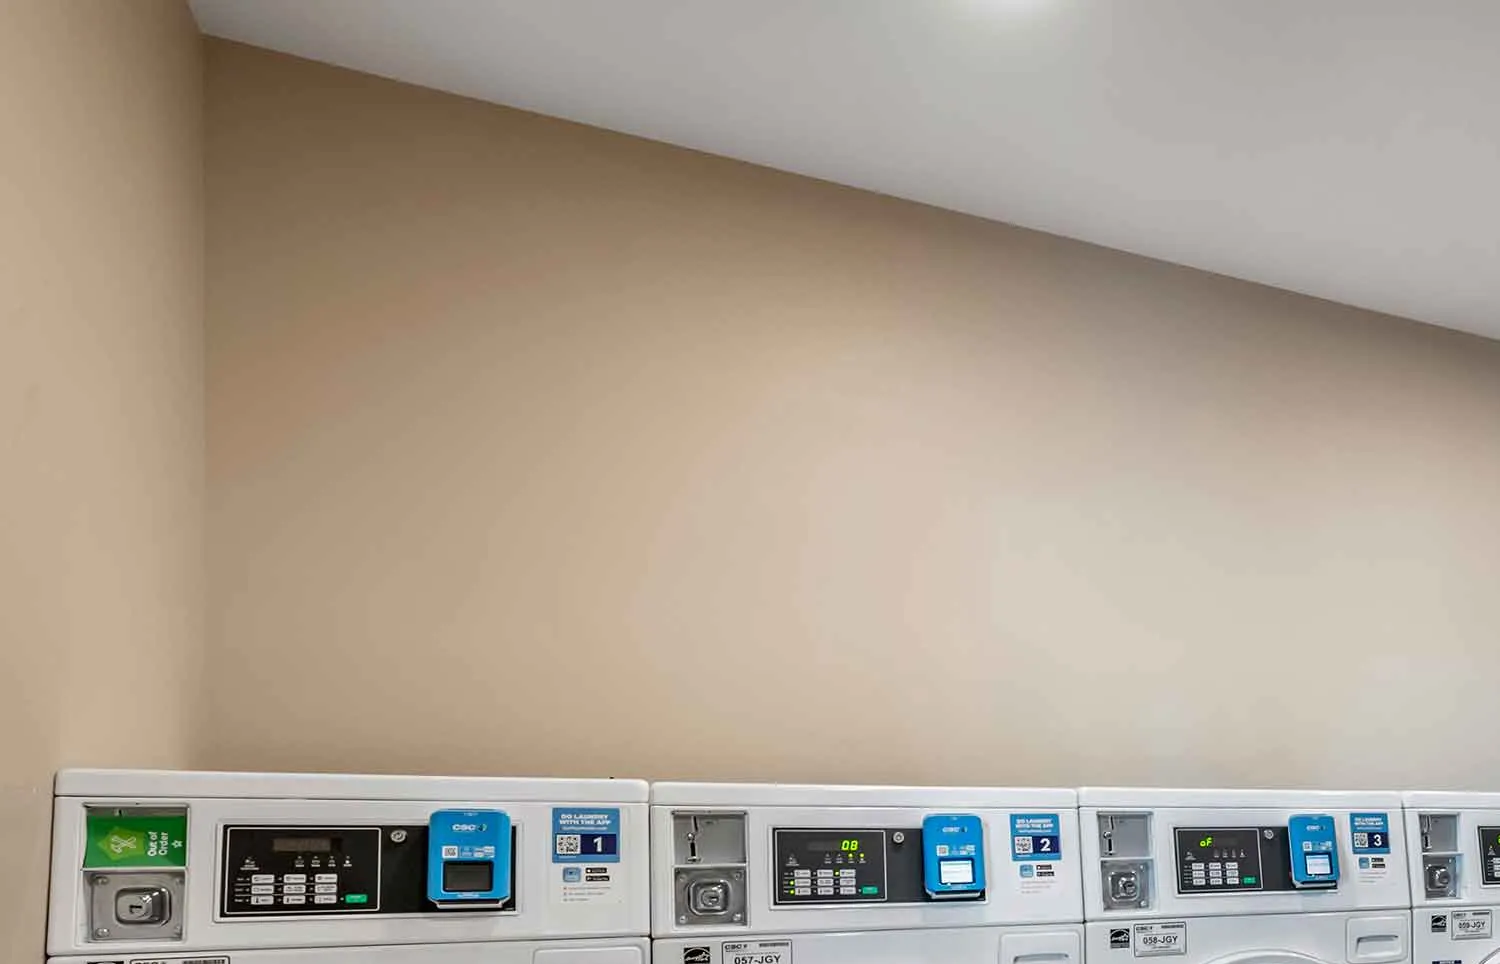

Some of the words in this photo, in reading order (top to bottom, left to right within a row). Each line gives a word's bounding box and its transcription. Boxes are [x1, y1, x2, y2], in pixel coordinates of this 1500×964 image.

[592, 835, 603, 853] 1
[841, 839, 858, 851] 08
[1039, 837, 1051, 852] 2
[1373, 834, 1383, 847] 3
[1143, 935, 1178, 945] 058-JGY
